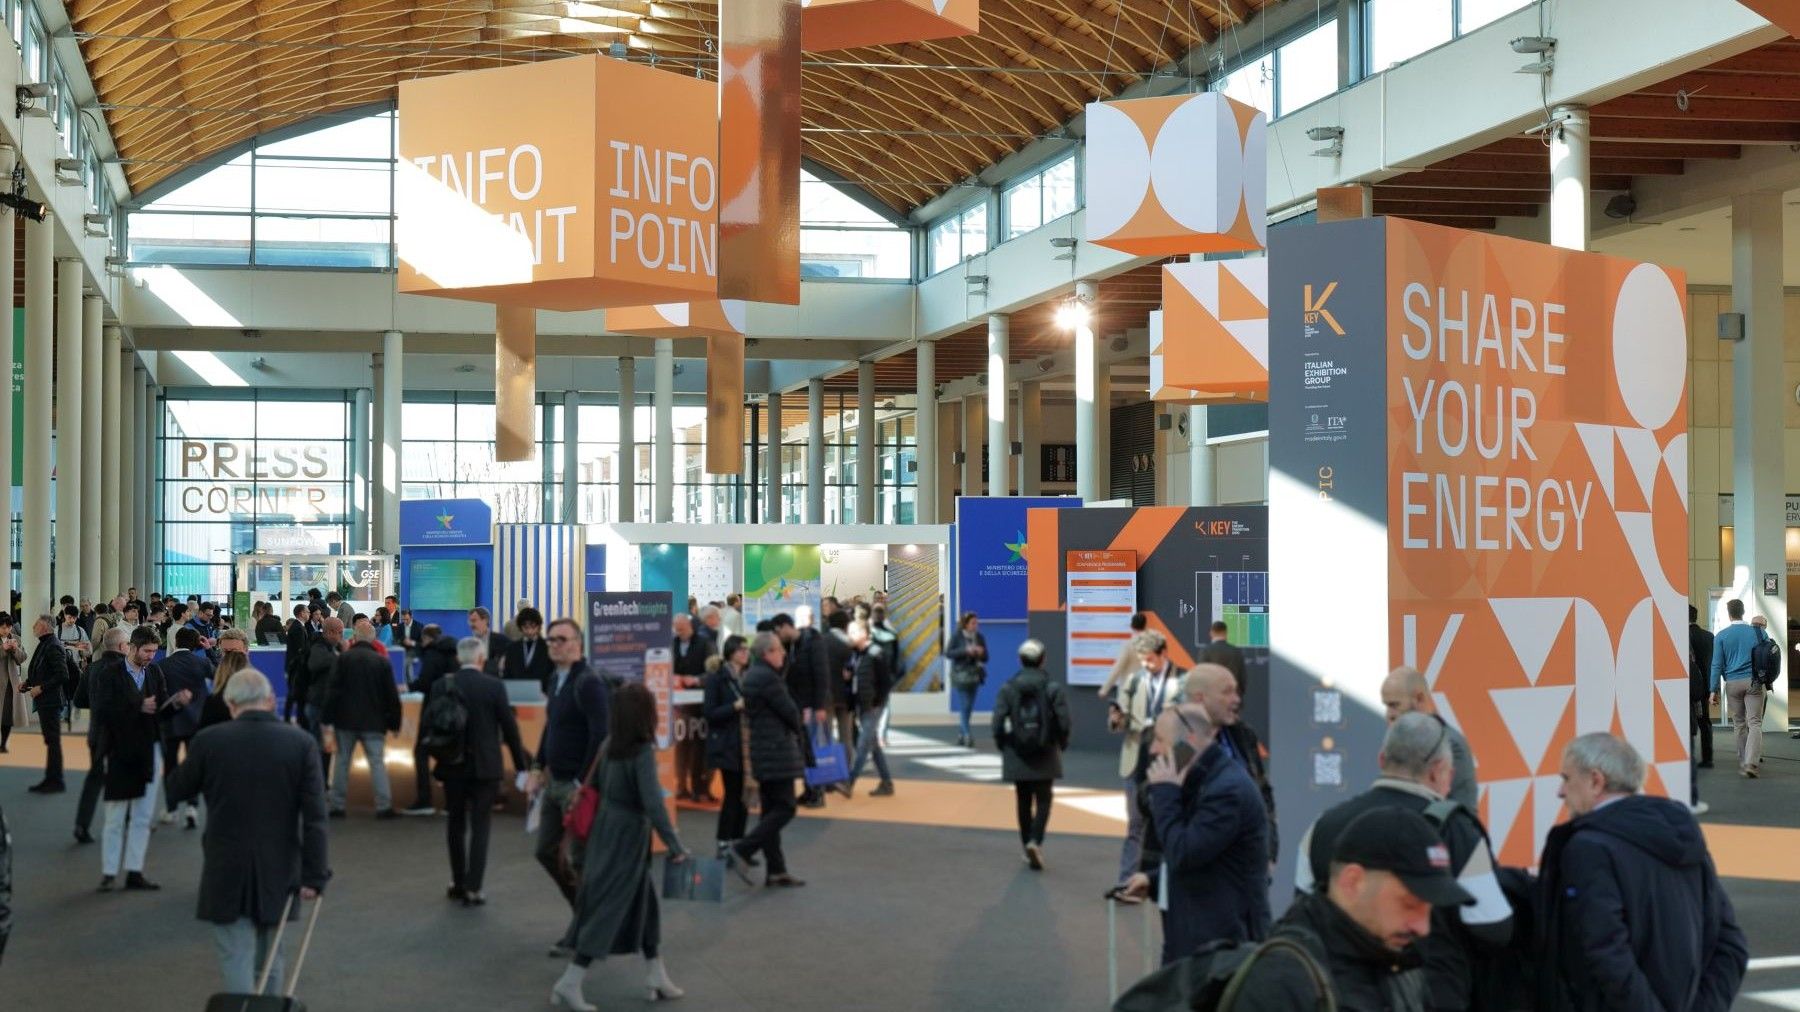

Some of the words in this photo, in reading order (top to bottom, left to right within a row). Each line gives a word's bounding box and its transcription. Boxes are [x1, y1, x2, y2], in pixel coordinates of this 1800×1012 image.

[609, 140, 716, 212] INFO
[610, 207, 716, 277] POIN
[1304, 312, 1319, 324] KEY
[1402, 282, 1566, 375] SHARE
[1304, 361, 1333, 370] ITALIAN
[1304, 368, 1347, 377] EXHIBITION
[1304, 377, 1331, 385] GROUP
[1402, 377, 1538, 461] YOUR
[182, 441, 328, 478] PRESS
[1402, 472, 1593, 551] ENERGY
[1786, 501, 1800, 511] PU
[1210, 521, 1231, 535] KEY
[361, 569, 380, 578] GSE
